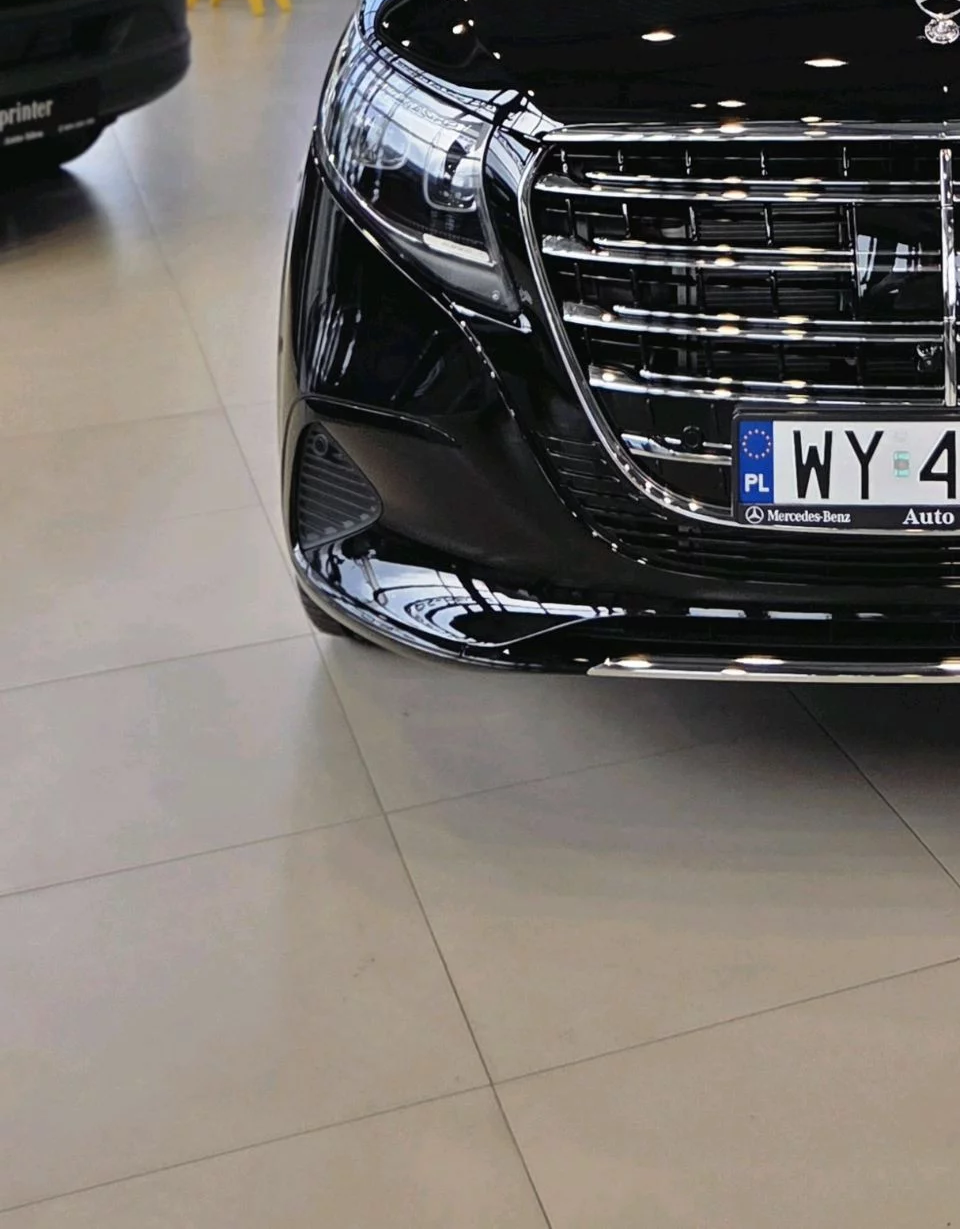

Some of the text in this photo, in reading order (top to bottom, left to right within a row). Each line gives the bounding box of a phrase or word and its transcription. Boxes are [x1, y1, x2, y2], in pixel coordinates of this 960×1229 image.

[793, 430, 884, 499] WY
[744, 473, 770, 492] PL
[767, 509, 851, 523] Mercedes-Benz
[902, 508, 955, 525] Auto
